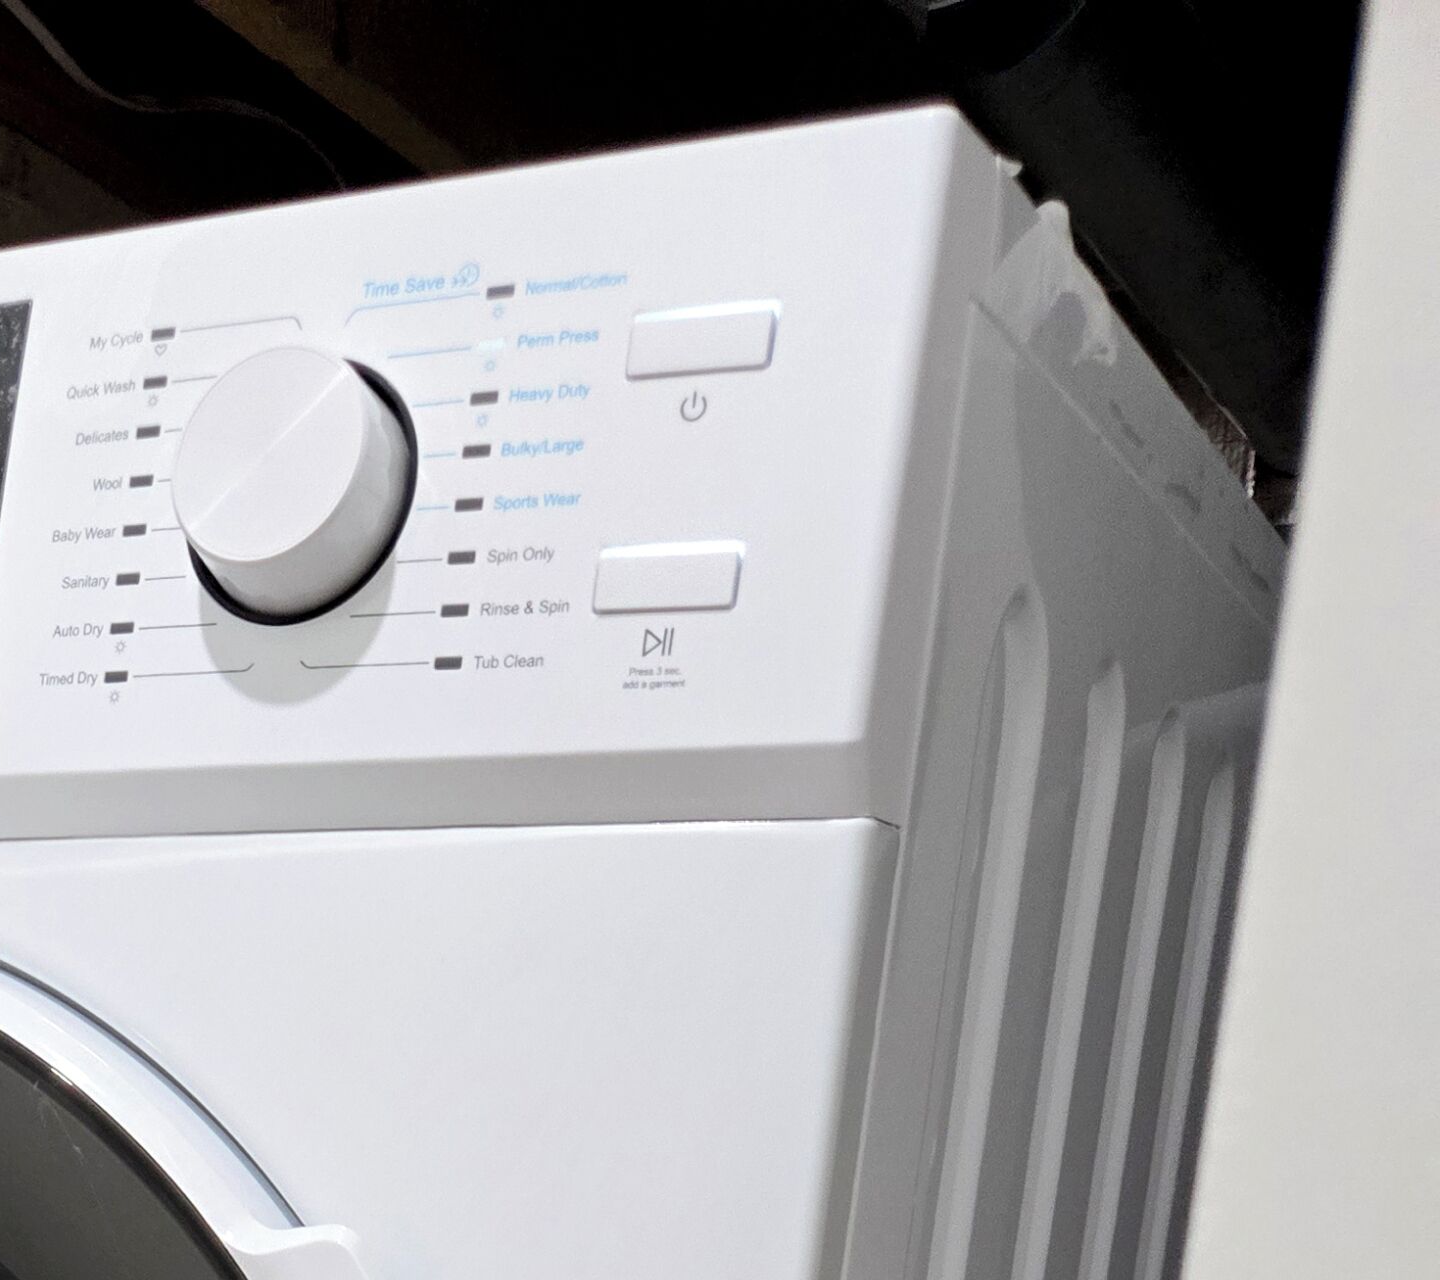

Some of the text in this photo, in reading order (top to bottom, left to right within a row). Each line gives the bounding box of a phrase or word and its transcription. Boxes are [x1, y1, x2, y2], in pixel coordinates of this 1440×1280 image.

[364, 276, 445, 298] Time Save
[525, 274, 628, 295] Normal/Cotton
[90, 331, 143, 350] My Cycle
[517, 330, 599, 348] Perm Press
[67, 380, 136, 399] Quick Wash
[509, 384, 591, 406] Heavy Duty
[75, 430, 129, 446] Delicates
[501, 438, 585, 458] Bulky/Large
[93, 477, 122, 491] Wool
[494, 493, 581, 512] Sports Wear
[52, 527, 117, 543] Baby Wear
[487, 547, 555, 566] Spin Only
[61, 575, 110, 590] Sanitary
[481, 600, 570, 616] Rinse & Spin
[53, 624, 104, 638] Auto Dry
[474, 654, 543, 669] Tub Clean
[39, 671, 98, 686] Timed Dry
[629, 667, 654, 676] Press
[622, 679, 685, 690] add a garment
